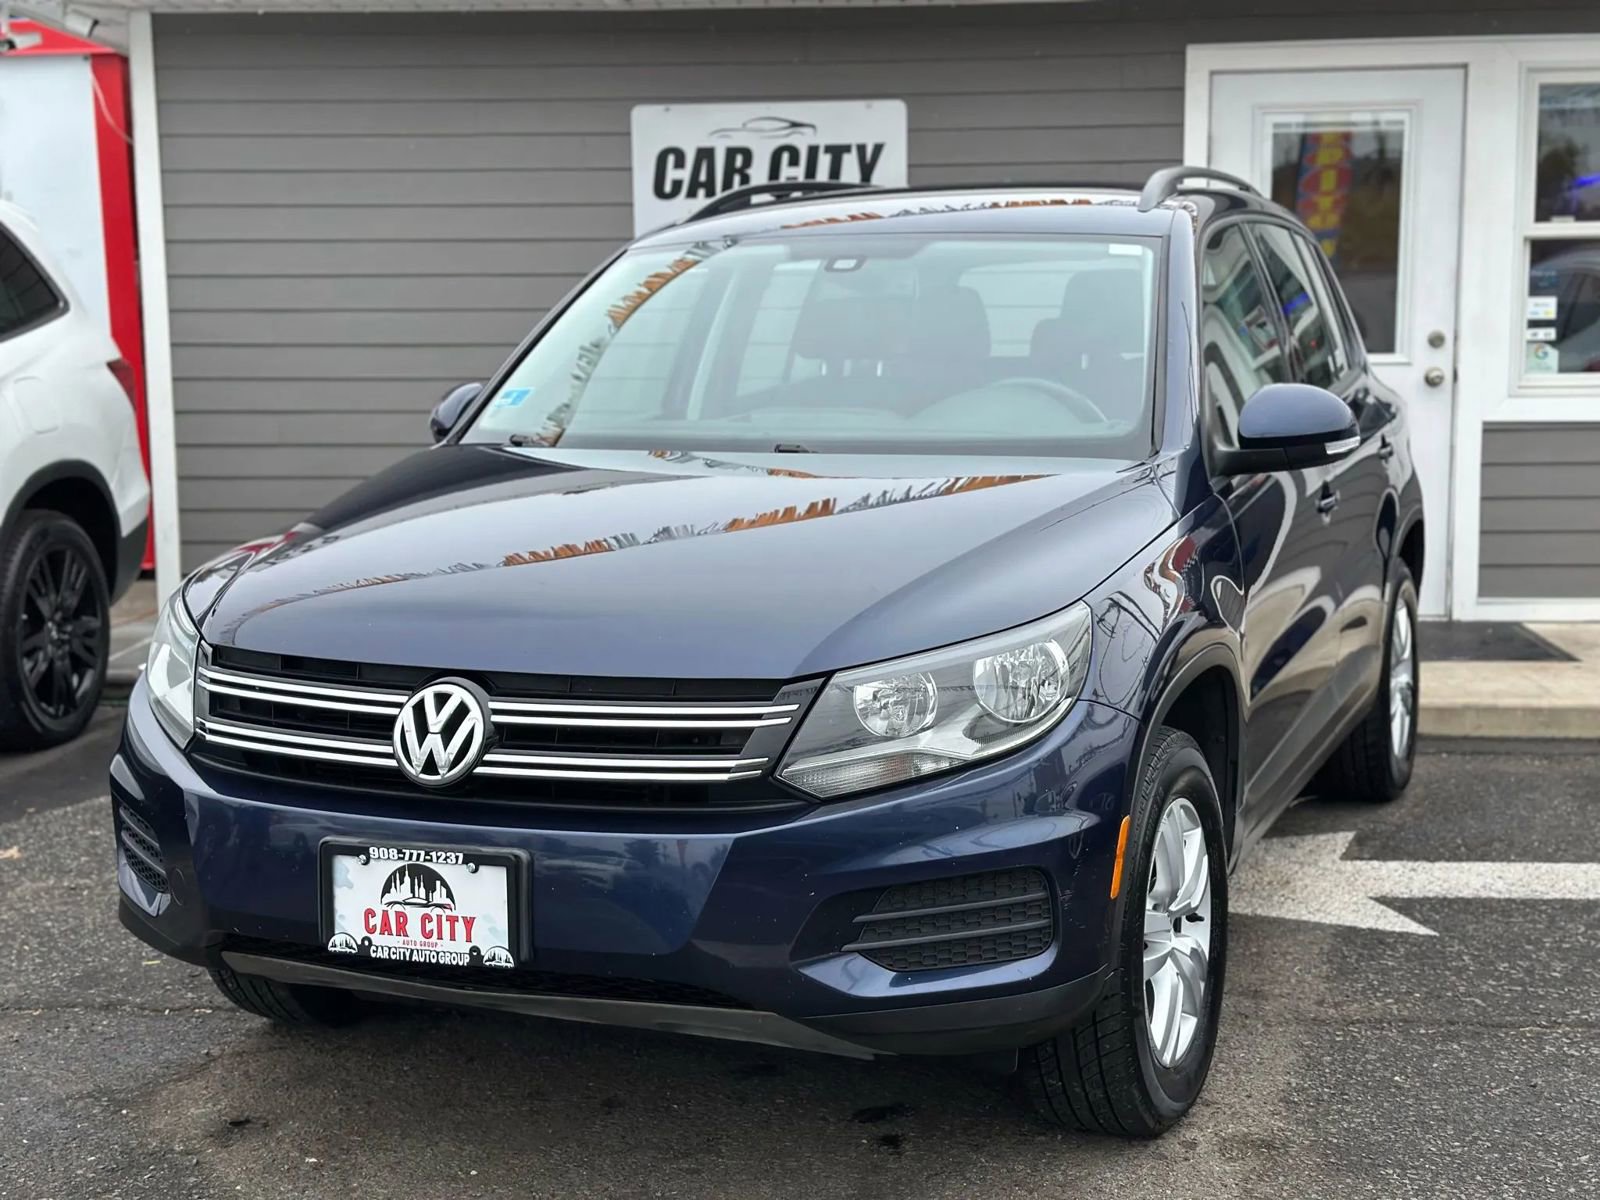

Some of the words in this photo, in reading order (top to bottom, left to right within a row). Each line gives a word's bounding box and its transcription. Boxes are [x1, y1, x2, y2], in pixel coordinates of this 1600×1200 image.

[653, 145, 754, 201] CAR
[767, 142, 886, 185] CITY
[369, 847, 464, 865] 908-777-1237
[364, 908, 409, 937] CAR
[421, 912, 476, 943] CITY
[402, 939, 417, 947] AUTO
[419, 940, 439, 949] GROUP
[370, 945, 390, 960] CAR
[389, 947, 412, 961] CITY
[411, 949, 438, 964] AUTO
[438, 952, 470, 967] GROUP
